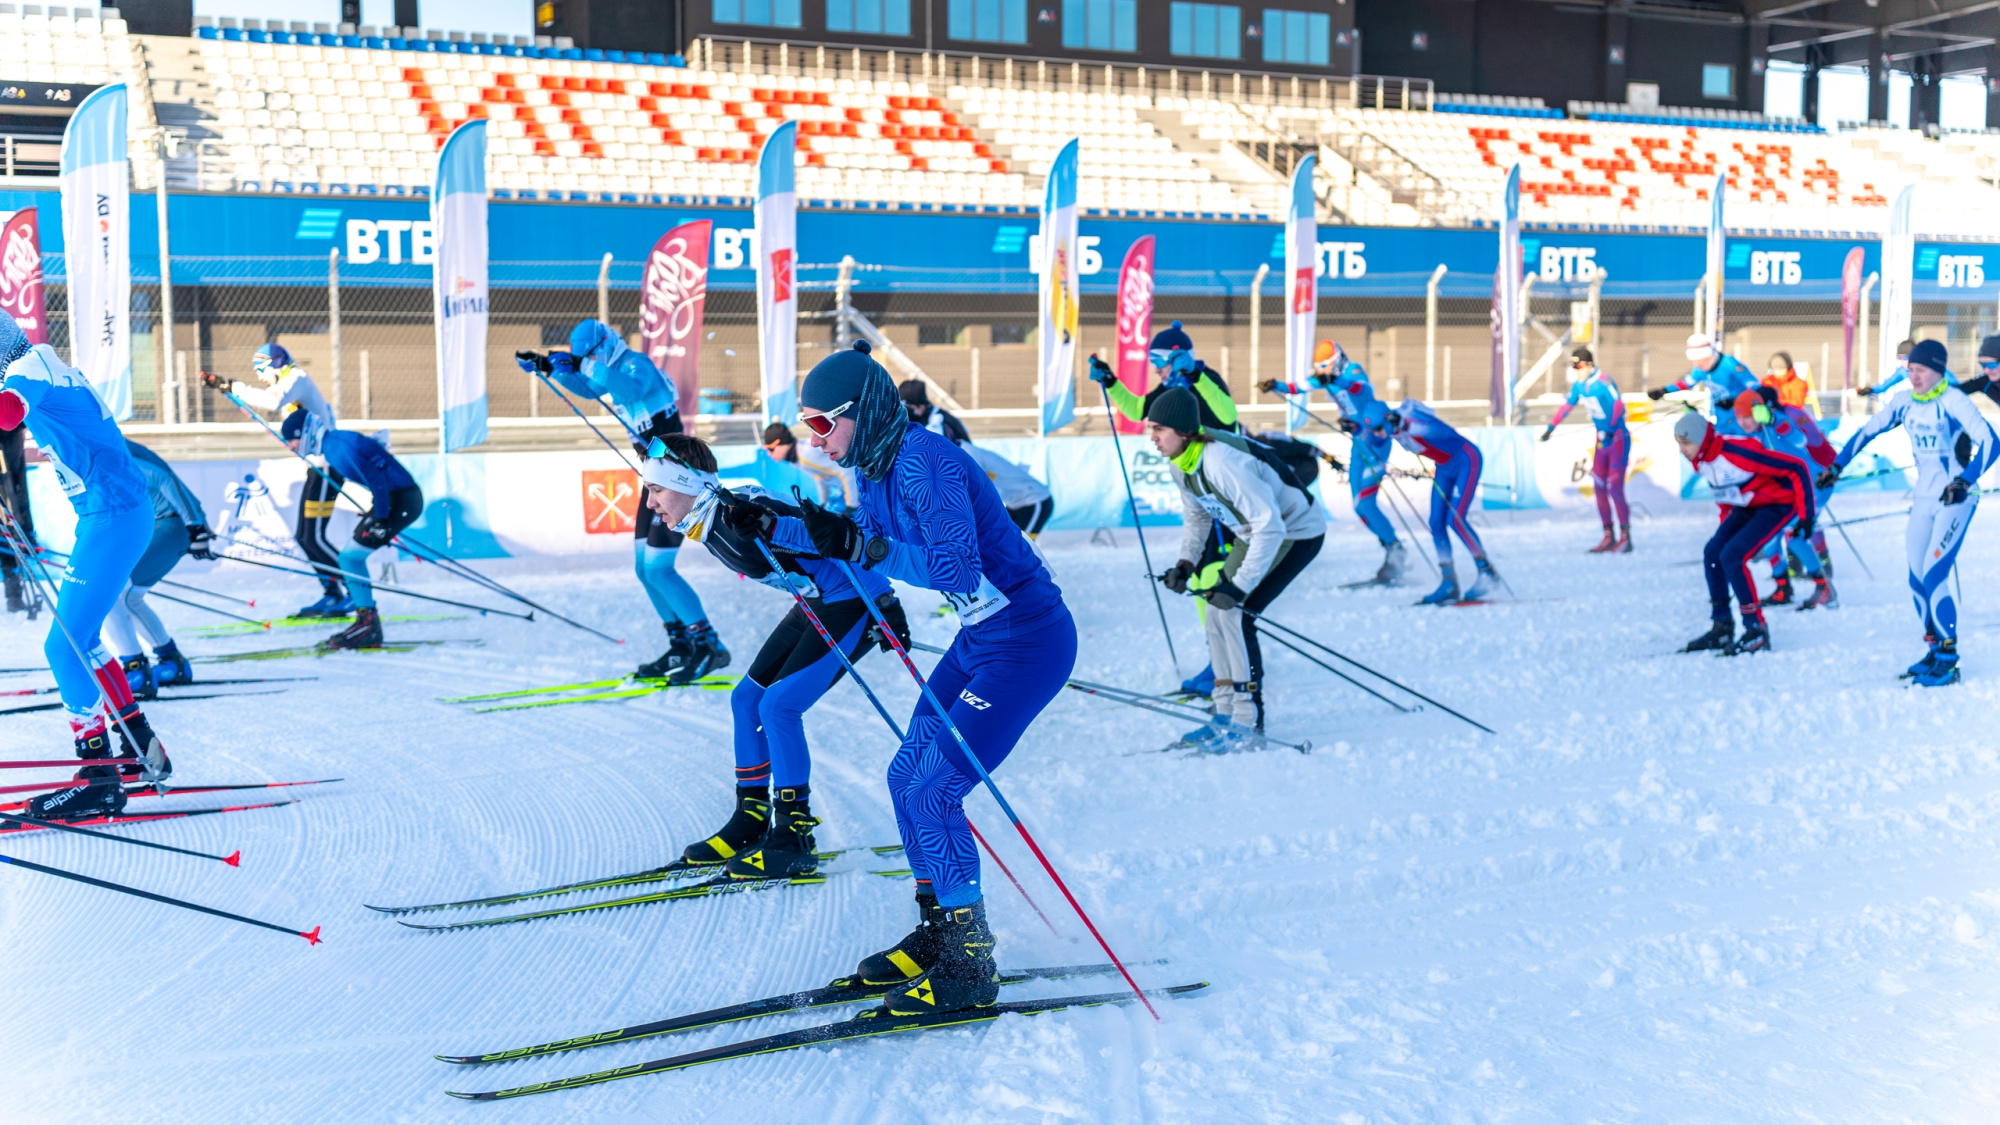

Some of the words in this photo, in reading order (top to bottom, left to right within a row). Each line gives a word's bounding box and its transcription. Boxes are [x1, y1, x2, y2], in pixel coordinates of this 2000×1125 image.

[346, 219, 433, 265] ВТБ
[1540, 246, 1598, 283] ВТБ
[1750, 251, 1802, 285] ВТБ
[1938, 255, 1985, 288] ВТБ
[665, 865, 727, 880] FISCH
[707, 878, 792, 895] FISCHER
[481, 1029, 625, 1062] FISCHER
[496, 1064, 645, 1097] FISCHER
